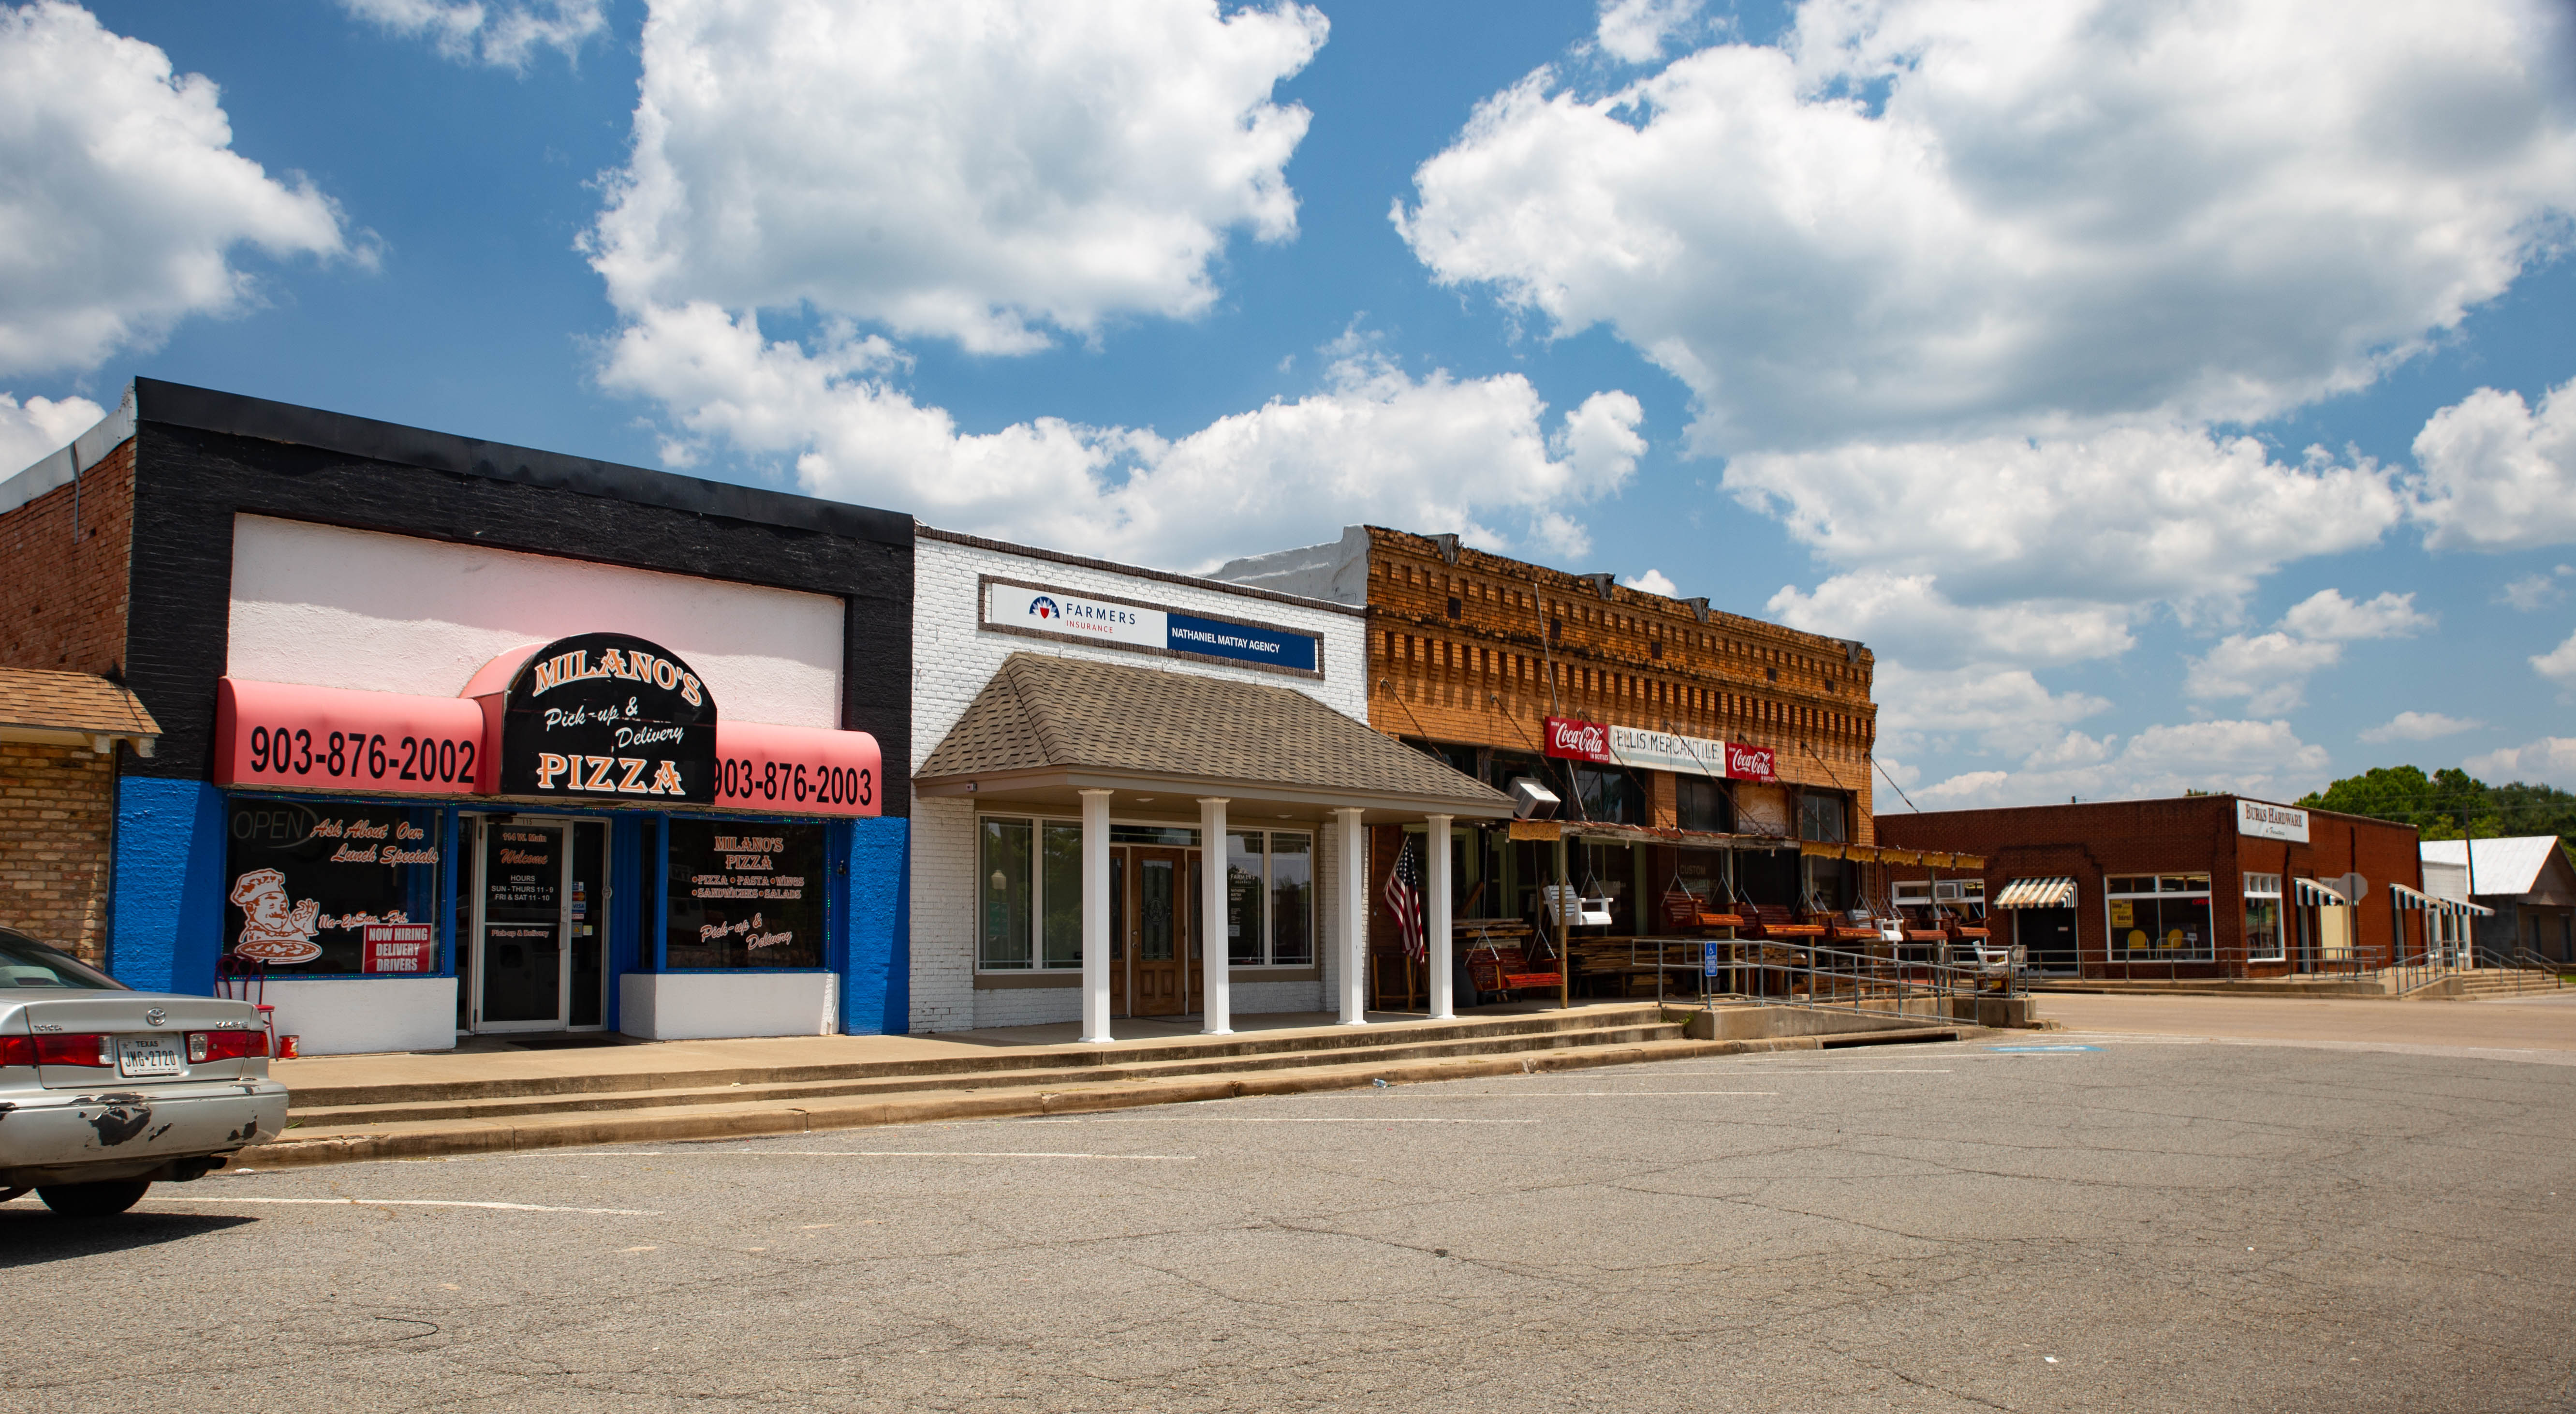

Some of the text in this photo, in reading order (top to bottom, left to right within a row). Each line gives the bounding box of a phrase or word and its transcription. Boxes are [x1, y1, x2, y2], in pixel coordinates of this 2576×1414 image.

[1066, 603, 1135, 625] FARMERS
[1066, 619, 1113, 633] INSURANCE
[1172, 627, 1280, 653] NATHANIEL MATTAY AGENCY
[532, 648, 702, 707] MILANO'S
[545, 696, 638, 732] Pick-up &
[615, 726, 683, 748] Delivery
[1617, 729, 1646, 750] ELLIS
[250, 726, 475, 783] 903-876-2002
[536, 752, 686, 795] PIZZA
[234, 811, 305, 839] OPEN
[309, 818, 424, 840] Ask About Our
[502, 832, 547, 842] 114 W. Main
[714, 836, 784, 853] MILANO'S
[330, 843, 439, 867] Lunch Specials
[500, 848, 548, 865] Welcome
[725, 854, 774, 870] PIZZA
[1680, 864, 1706, 875] CUSTOM
[698, 875, 805, 886] PIZZA PASTA WINGS
[697, 887, 802, 899] SANDWICHES SALADS
[368, 928, 428, 941] NOW HIRING
[491, 929, 516, 938] Pick-up
[523, 929, 549, 938] Delivery
[700, 913, 762, 943] Pick-up &
[376, 943, 420, 957] DELIVERY
[746, 931, 793, 950] Delivery
[376, 958, 418, 972] DRIVERS
